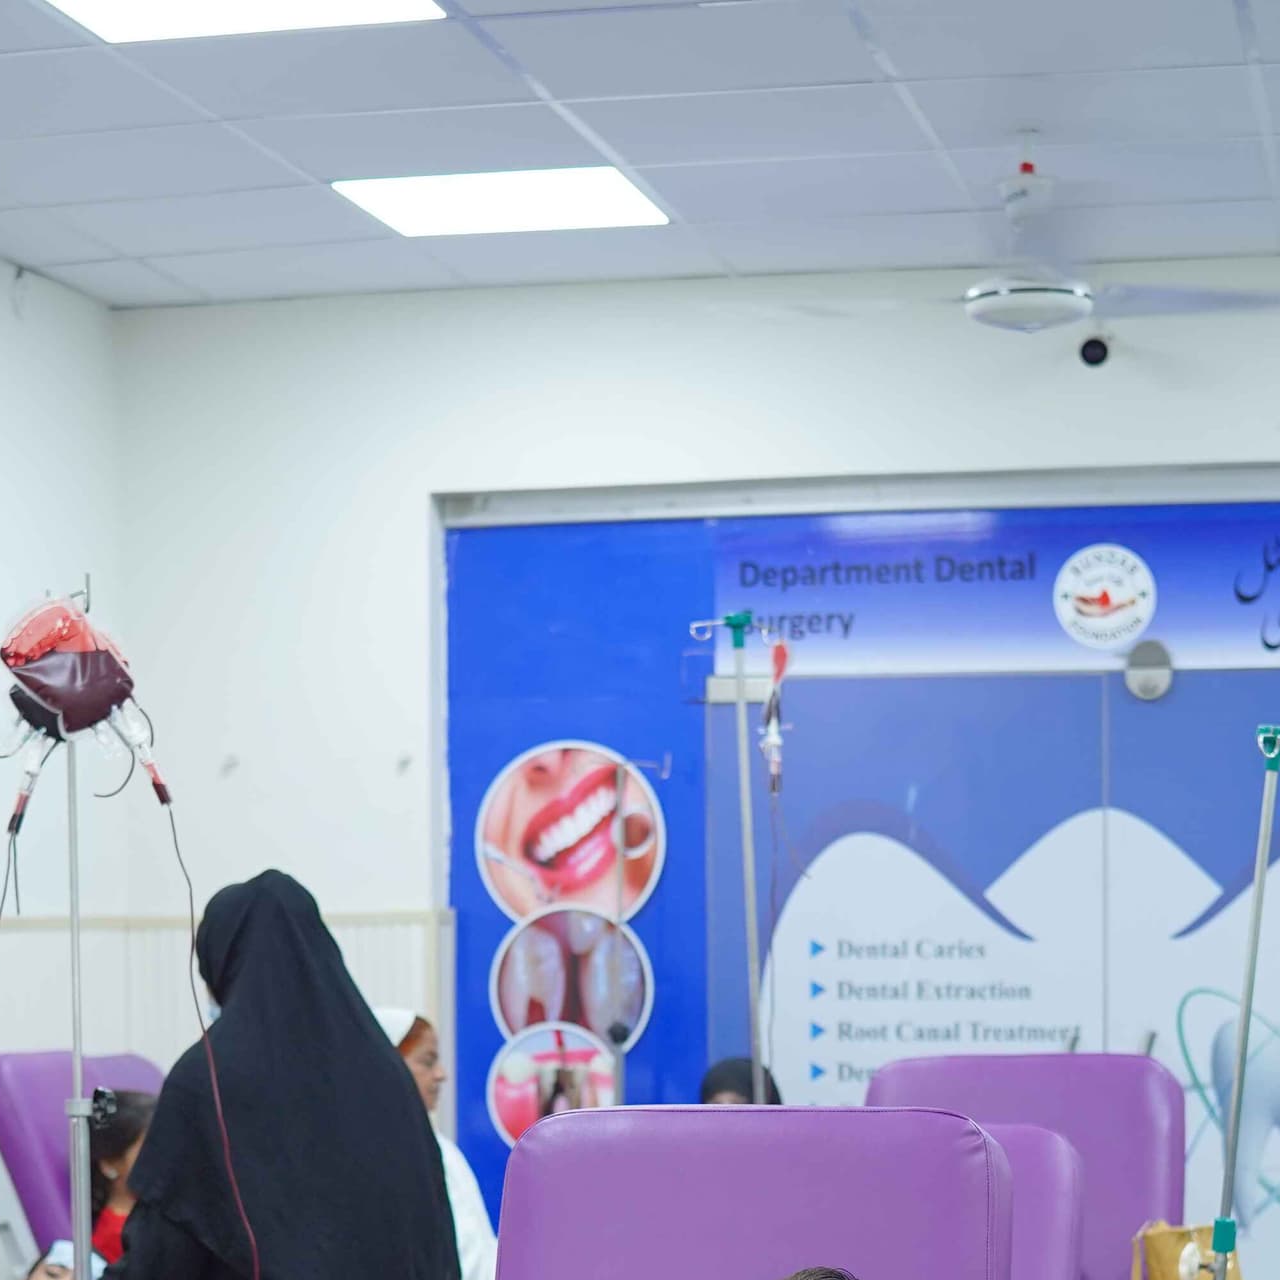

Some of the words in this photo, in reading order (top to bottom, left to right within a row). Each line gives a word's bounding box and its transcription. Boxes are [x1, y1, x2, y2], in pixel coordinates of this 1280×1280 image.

[739, 559, 926, 592] Department
[933, 553, 1038, 582] Dental
[837, 938, 909, 960] Dental
[915, 938, 986, 960] Caries
[837, 979, 909, 1001] Dental
[916, 979, 1033, 1001] Extraction
[837, 1021, 888, 1042] Root
[895, 1021, 961, 1042] Canal
[967, 1021, 1081, 1042] Treatment
